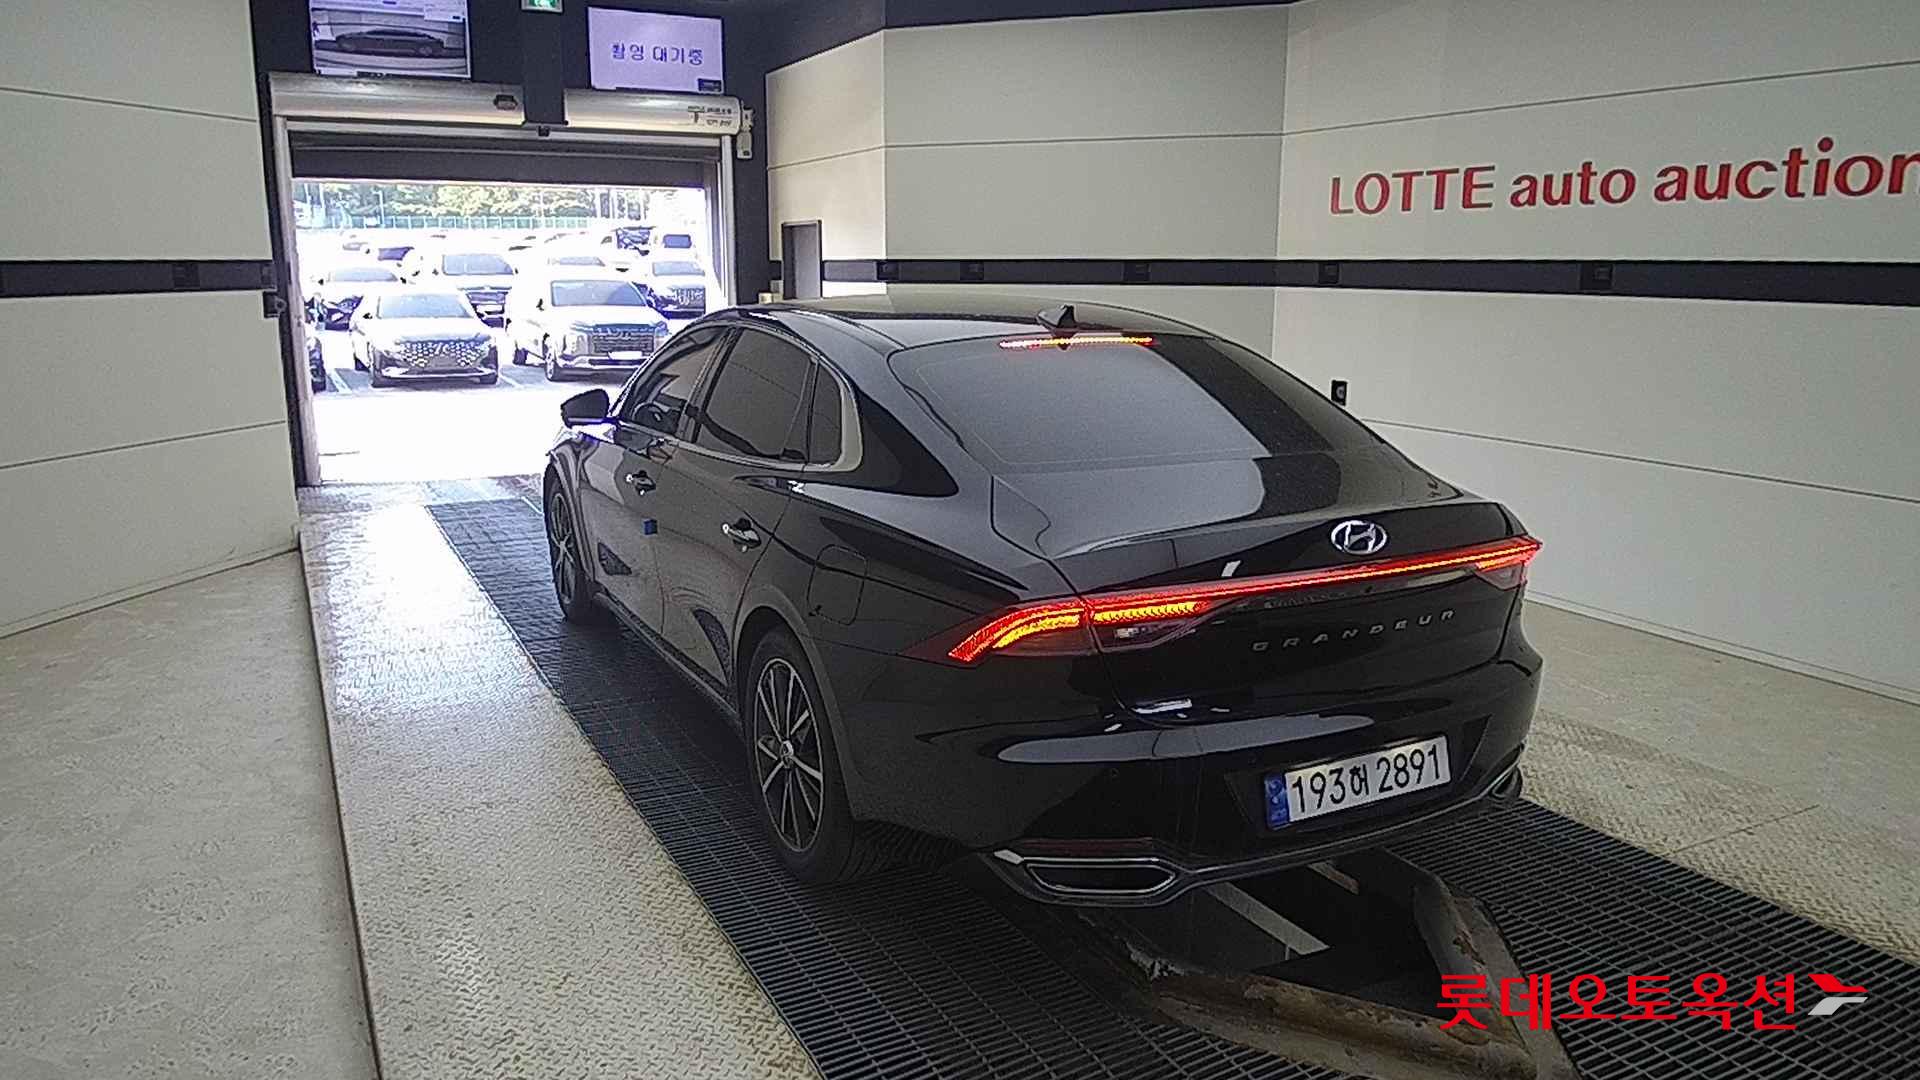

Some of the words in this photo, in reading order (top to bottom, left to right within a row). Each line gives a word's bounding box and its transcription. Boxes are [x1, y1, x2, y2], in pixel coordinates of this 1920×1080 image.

[653, 45, 703, 66] 대기중
[1330, 166, 1496, 215] LOTTE
[1510, 161, 1637, 209] auto
[1252, 608, 1456, 652] GRANDEUR
[1292, 764, 1370, 813] 193허
[1376, 744, 1440, 793] 2891
